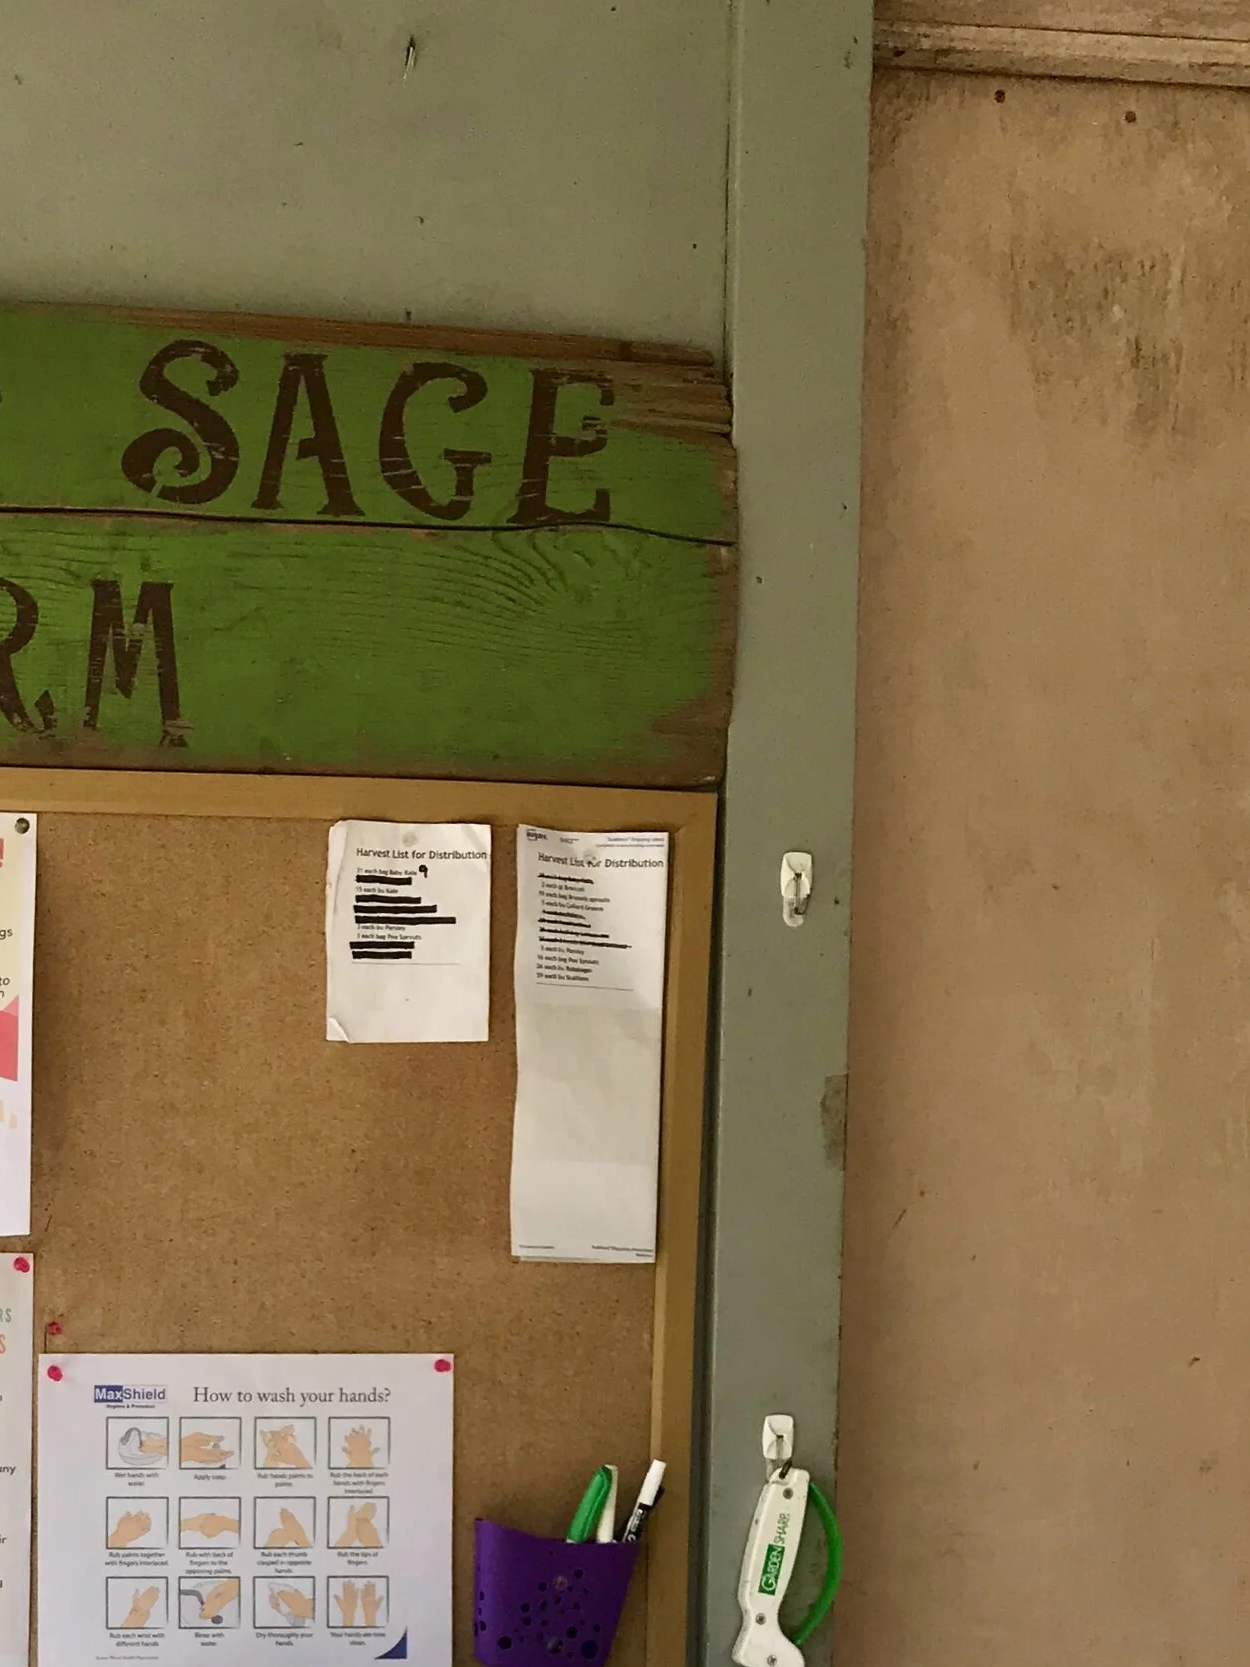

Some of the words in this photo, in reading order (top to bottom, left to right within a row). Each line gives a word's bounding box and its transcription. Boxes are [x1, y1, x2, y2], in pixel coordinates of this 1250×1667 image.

[122, 338, 616, 526] SAGE
[356, 848, 390, 858] Harvest
[392, 850, 409, 859] List
[412, 850, 426, 859] for
[430, 850, 487, 859] Distribution
[538, 852, 568, 865] Harvest
[570, 857, 585, 867] List
[605, 858, 663, 868] Distribution
[95, 1386, 167, 1402] MaxShield
[192, 1387, 233, 1403] How
[236, 1387, 253, 1403] to
[256, 1387, 296, 1403] wash
[299, 1392, 335, 1407] your
[338, 1387, 391, 1403] hands?
[761, 1545, 784, 1592] GARDEN
